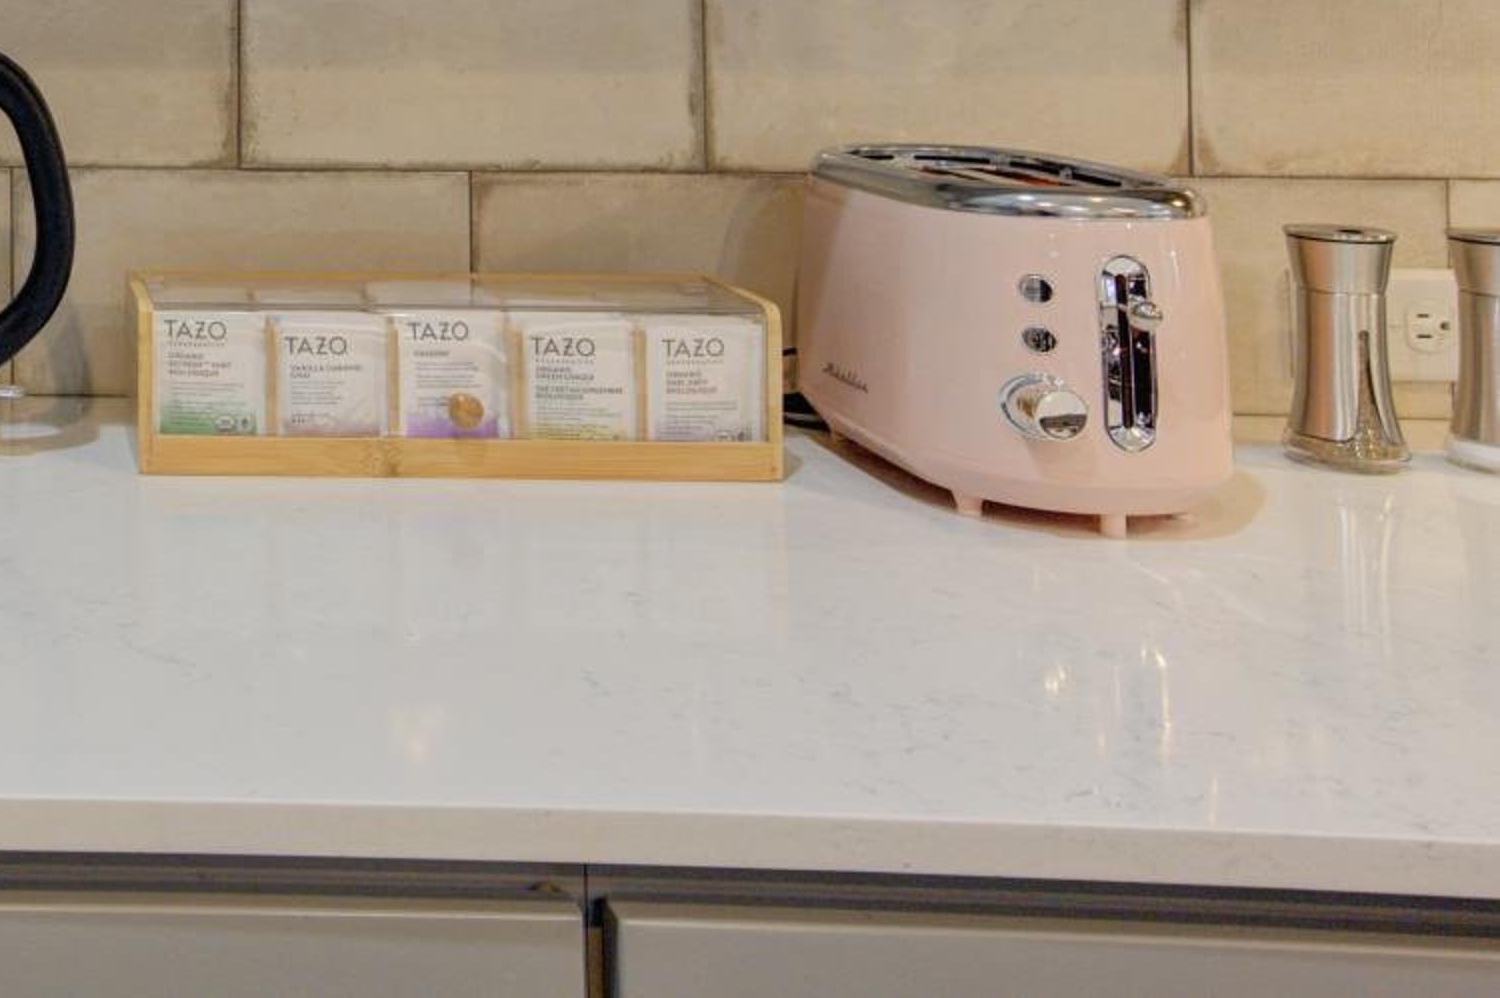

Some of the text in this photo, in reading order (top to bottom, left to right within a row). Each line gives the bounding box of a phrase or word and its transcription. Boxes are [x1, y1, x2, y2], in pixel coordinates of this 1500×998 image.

[164, 319, 227, 341] TAZO
[407, 321, 469, 342] TAZO
[284, 336, 347, 355] TAZO
[531, 337, 595, 357] TAZO
[661, 338, 725, 357] TAZO
